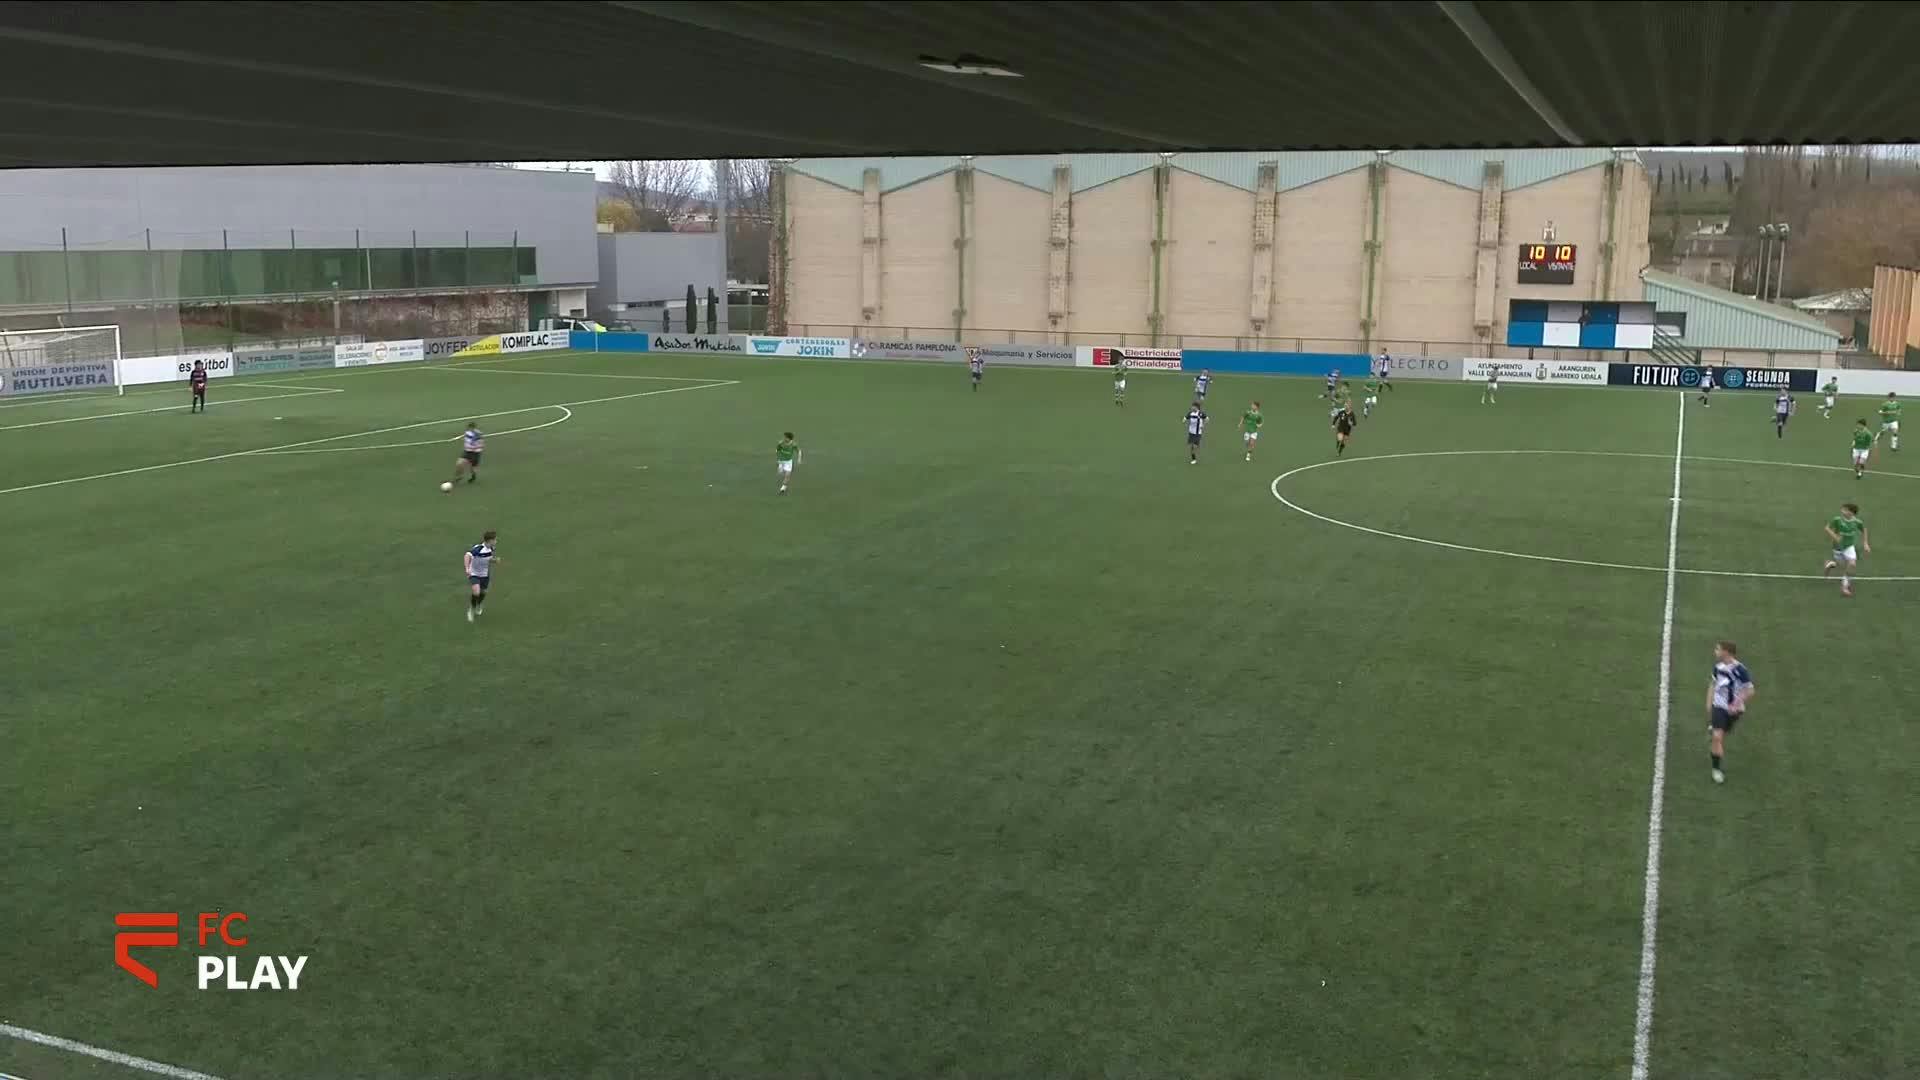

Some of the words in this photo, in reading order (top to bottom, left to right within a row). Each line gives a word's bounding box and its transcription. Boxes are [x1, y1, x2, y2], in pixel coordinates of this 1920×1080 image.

[1529, 246, 1546, 260] 10
[1555, 246, 1571, 261] 10
[1519, 261, 1537, 270] LOCAL
[1547, 261, 1574, 271] VISITANTE
[502, 333, 550, 349] KOMIPLAC
[425, 340, 468, 355] JOYFER
[797, 345, 835, 356] JOKIN
[868, 342, 914, 351] CRAMICAS
[915, 343, 957, 352] PAMPLONA
[1036, 350, 1073, 359] Servicios
[51, 364, 107, 375] DEPORTIVA
[178, 362, 192, 373] es
[198, 358, 230, 371] útbol
[1558, 364, 1596, 372] ARANGUREN
[1467, 369, 1487, 377] VALLE
[1745, 369, 1791, 384] SEGUNDA
[13, 373, 108, 391] MUTILVERA
